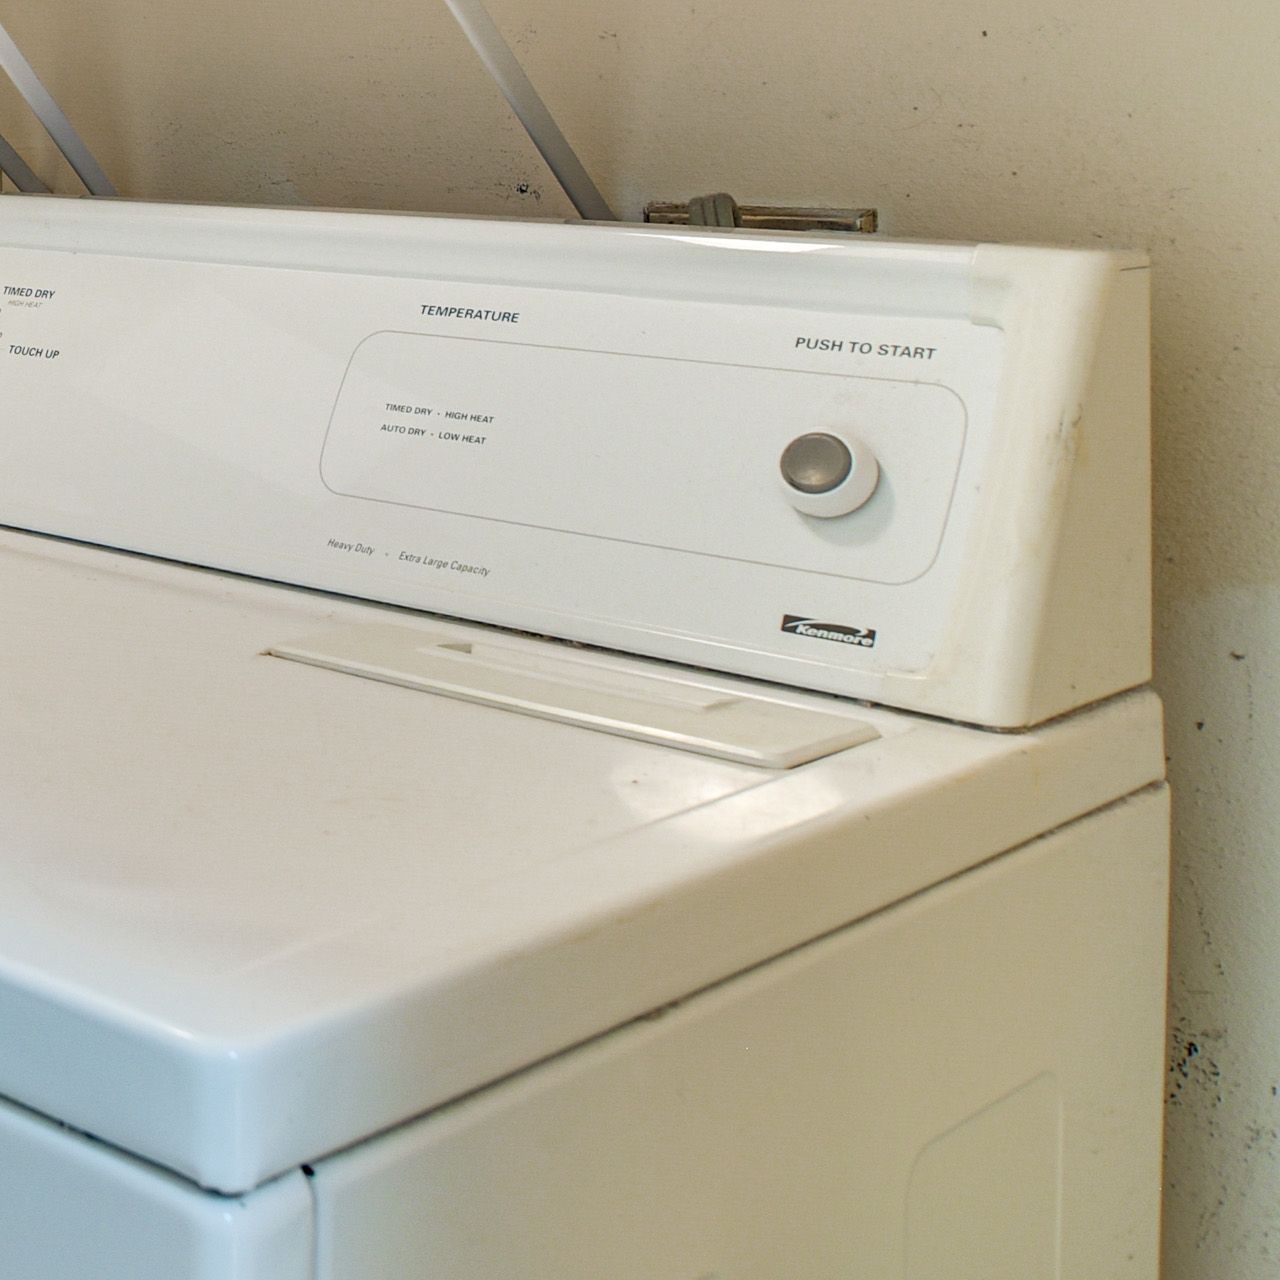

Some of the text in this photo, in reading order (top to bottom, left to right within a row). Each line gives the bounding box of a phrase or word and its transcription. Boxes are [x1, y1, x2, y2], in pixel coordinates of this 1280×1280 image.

[3, 286, 56, 300] TIMED DRY
[419, 304, 521, 325] TEMPERATURE
[9, 345, 60, 360] TOUCH UP
[793, 335, 937, 361] PUSH TO START
[385, 403, 495, 424] TIMED DRY HIGH HEAT
[380, 423, 487, 445] AUTO DRY LOW HEAT
[327, 538, 491, 577] Heavy Duty Extra Large Capacity
[795, 623, 874, 647] Kenmore
